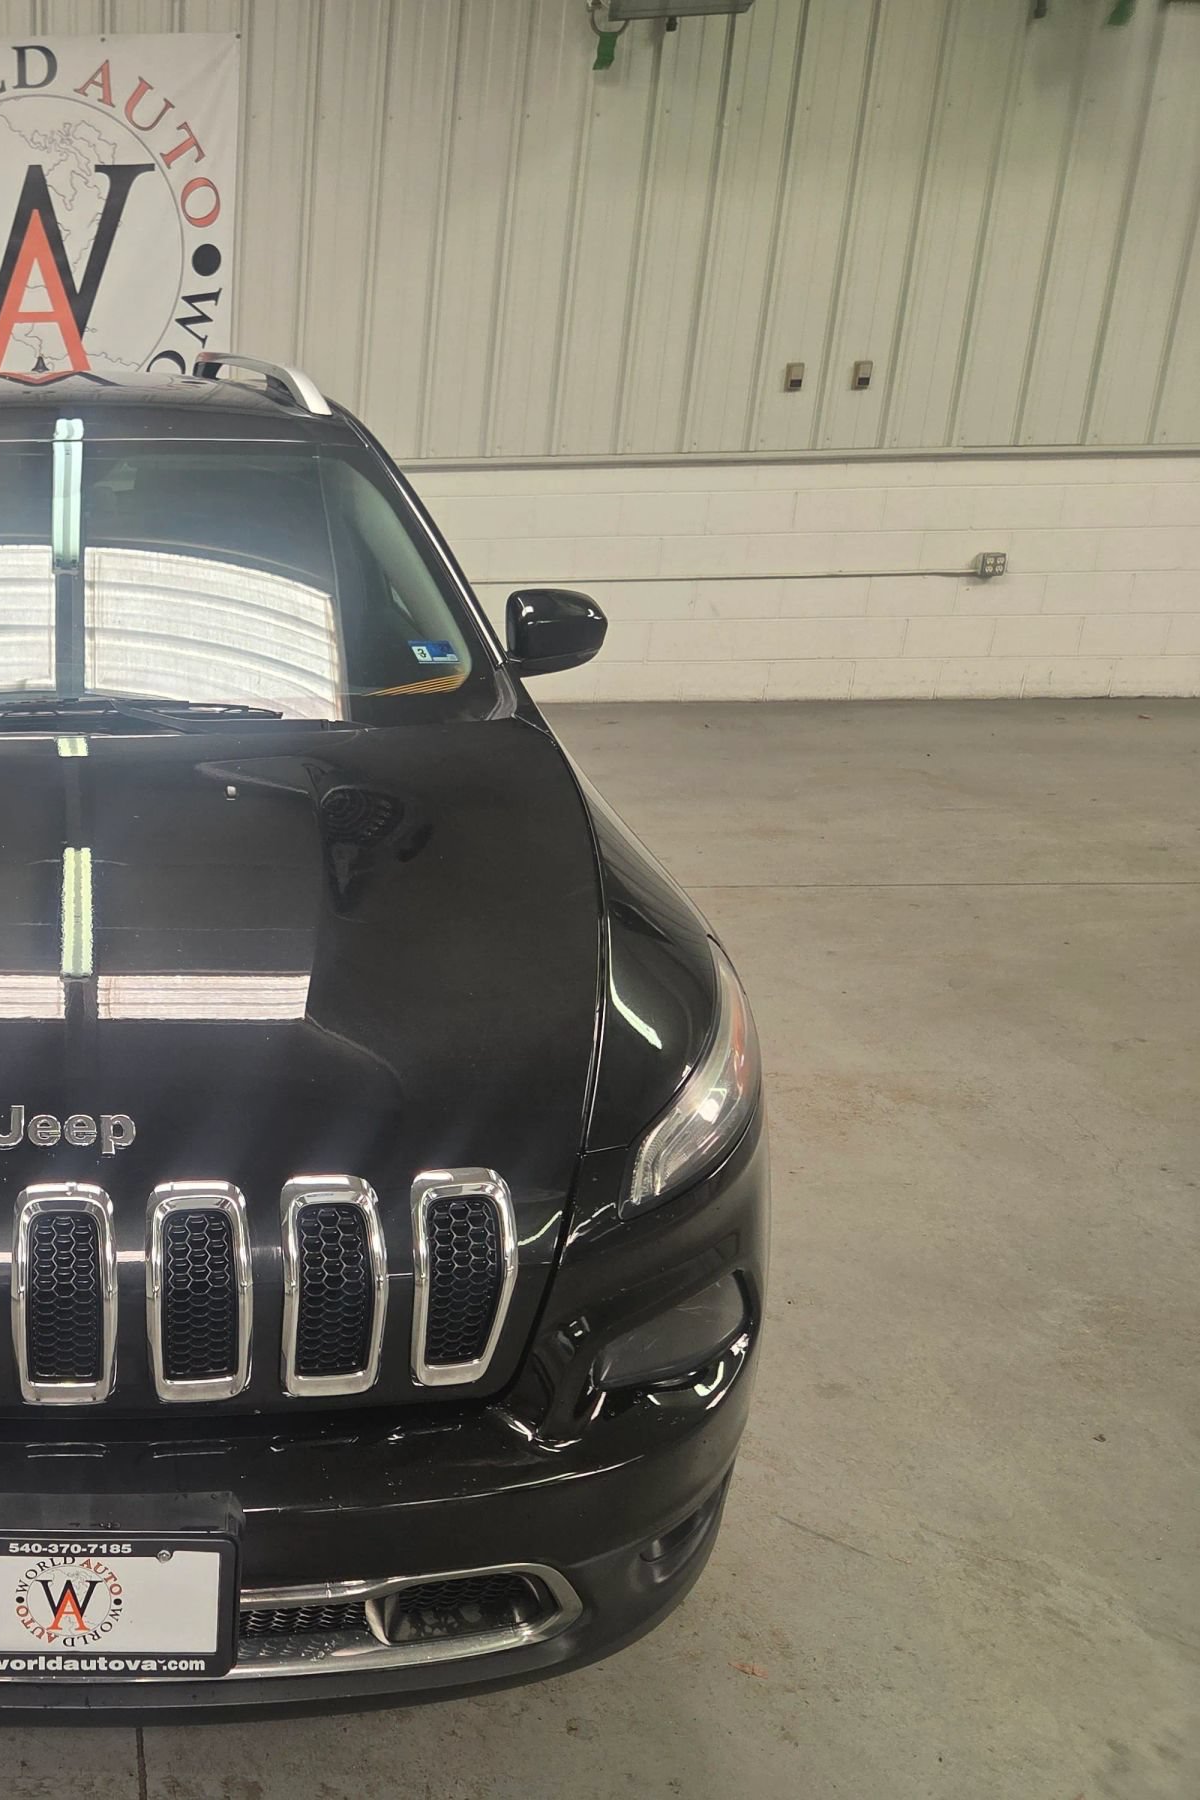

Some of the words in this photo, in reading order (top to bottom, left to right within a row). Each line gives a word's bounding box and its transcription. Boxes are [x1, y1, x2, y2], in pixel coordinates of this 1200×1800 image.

[73, 59, 221, 228] AUTO
[8, 1542, 132, 1554] 540-370-7185
[15, 1556, 76, 1593] WORLD
[79, 1558, 122, 1595] AUTO
[15, 1604, 60, 1644] AUTO
[62, 1607, 122, 1647] WORLD
